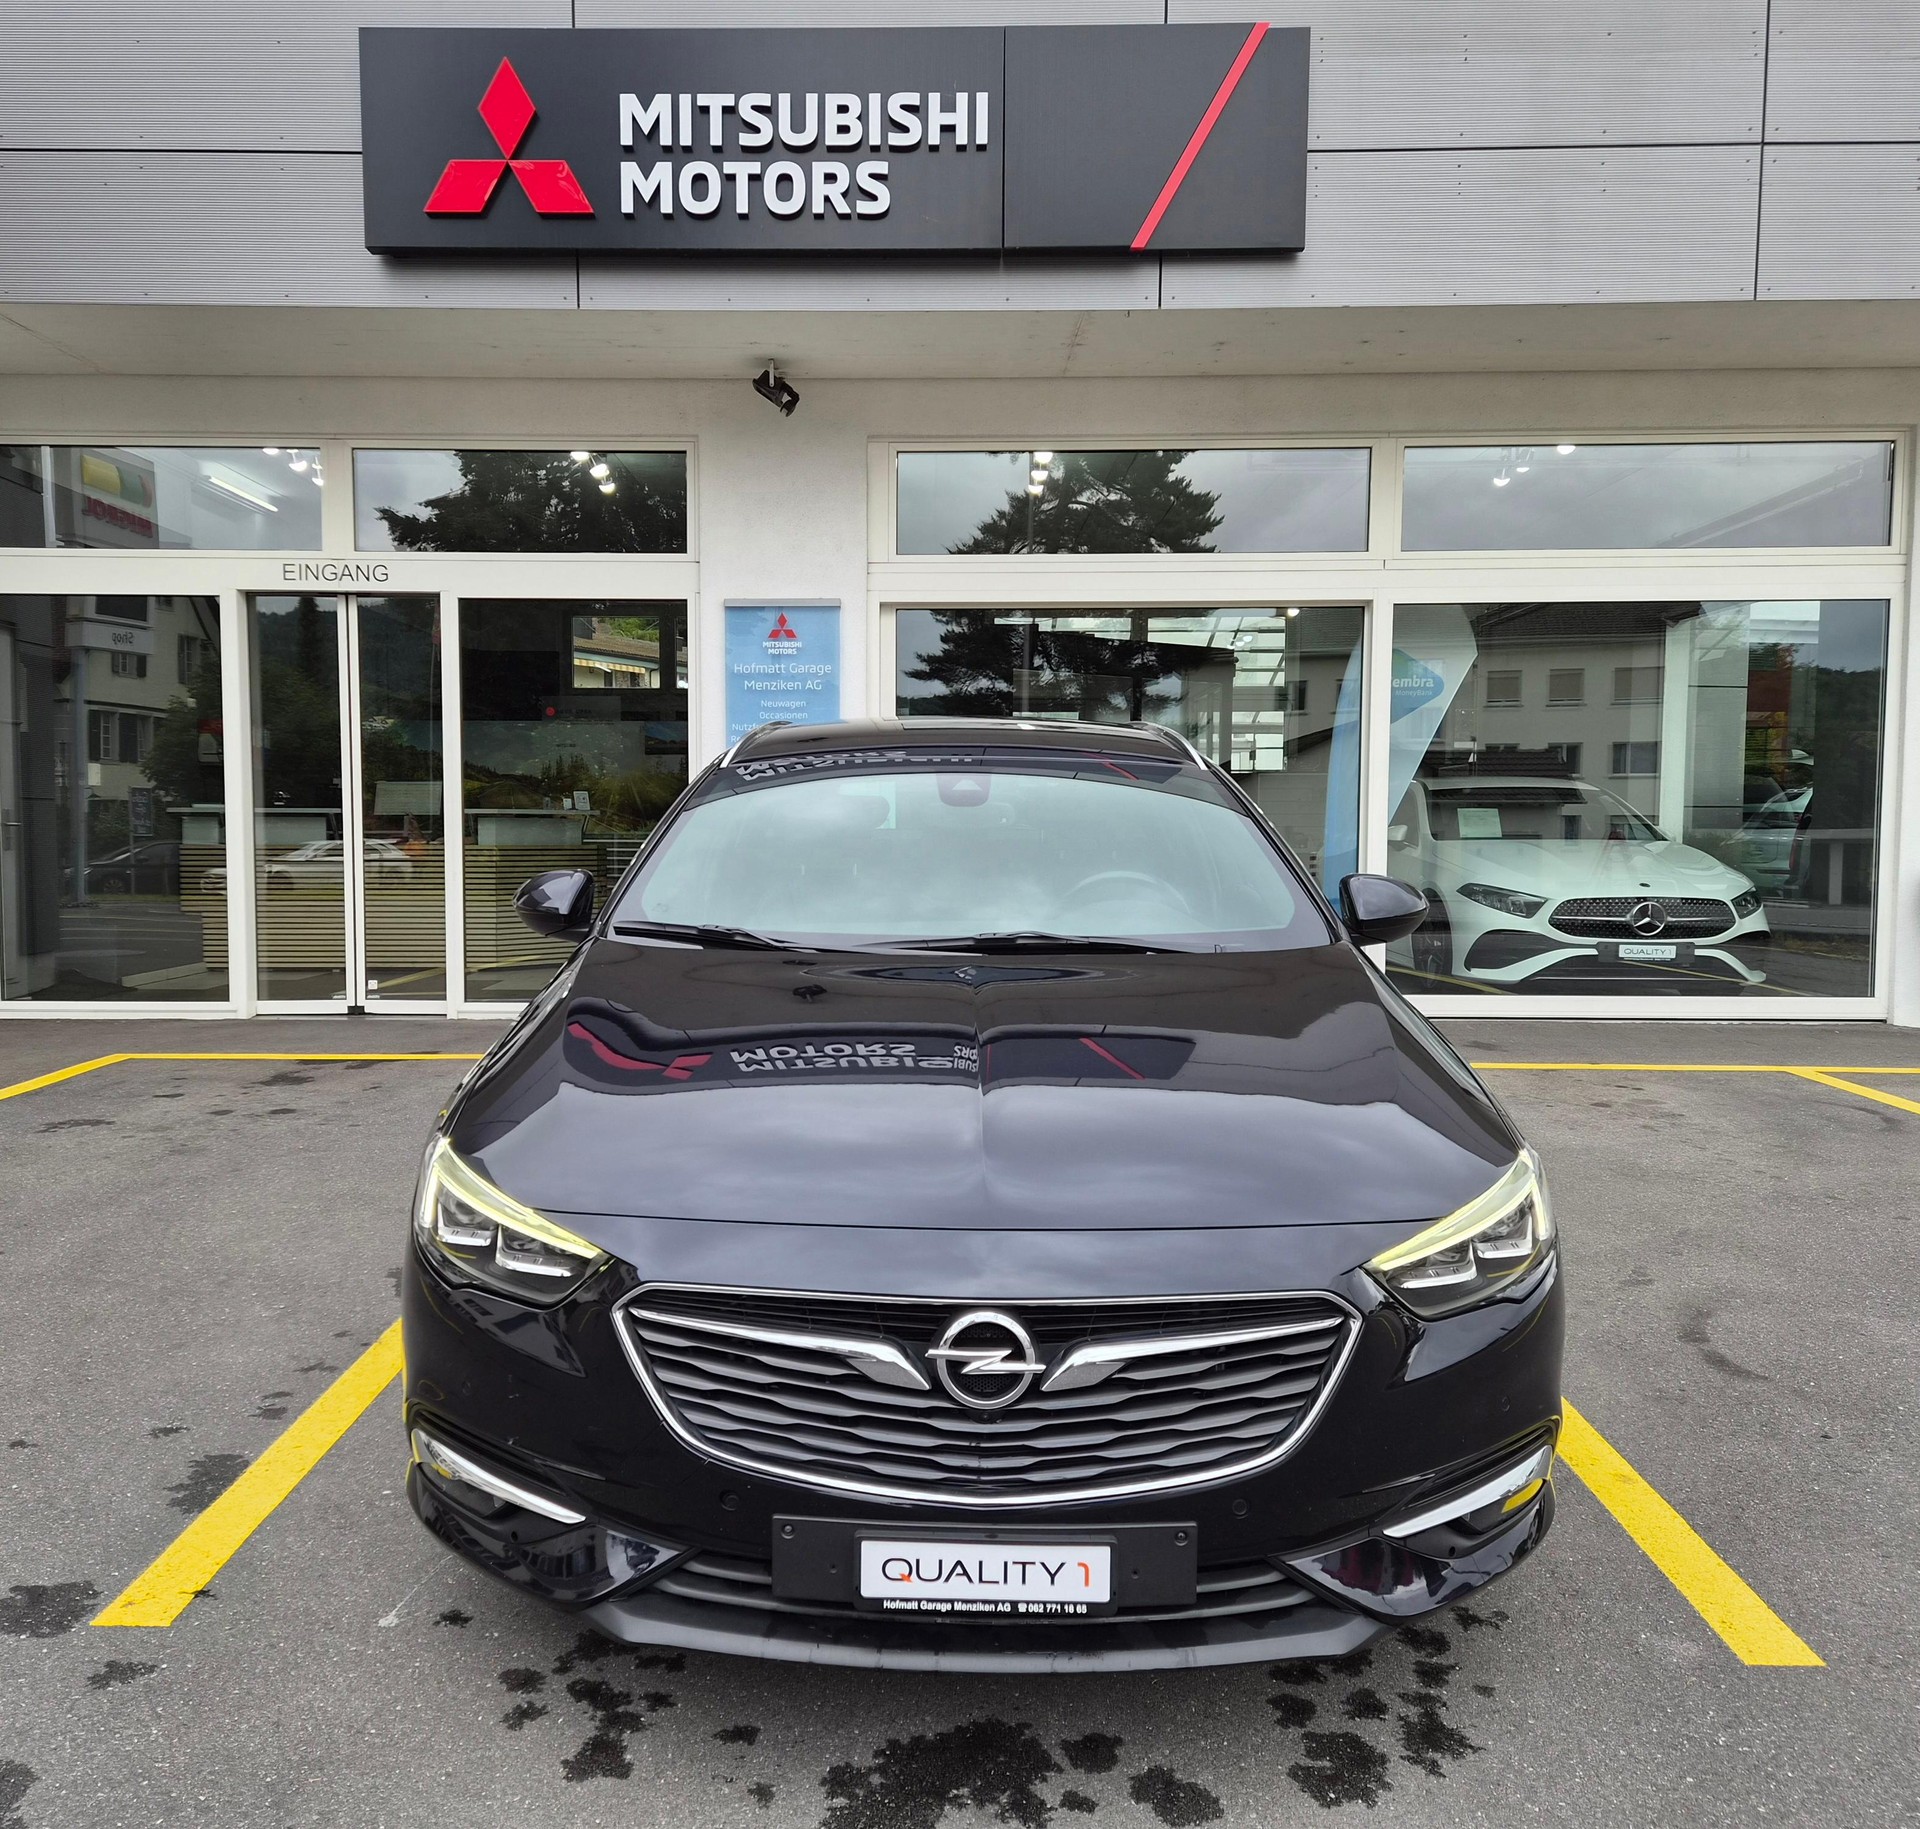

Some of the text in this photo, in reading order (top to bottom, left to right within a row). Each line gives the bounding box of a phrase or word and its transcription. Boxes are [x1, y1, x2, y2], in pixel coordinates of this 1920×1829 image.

[619, 92, 989, 148] MITSUBISHI
[619, 160, 891, 215] MOTORS
[282, 563, 389, 582] EINGANG
[734, 663, 832, 675] Hofmatt Garage
[744, 680, 822, 691] Menziken AG
[1392, 675, 1434, 688] embra
[760, 700, 806, 709] Neuwagen
[759, 711, 808, 720] Occasionen
[732, 723, 760, 731] Nutzf
[881, 1557, 1090, 1587] QUALITY 1
[883, 1600, 919, 1611] Hofmatt
[920, 1601, 952, 1613] Garage
[953, 1601, 995, 1612] Menziken
[997, 1602, 1012, 1613] AG
[1046, 1603, 1061, 1614] 771
